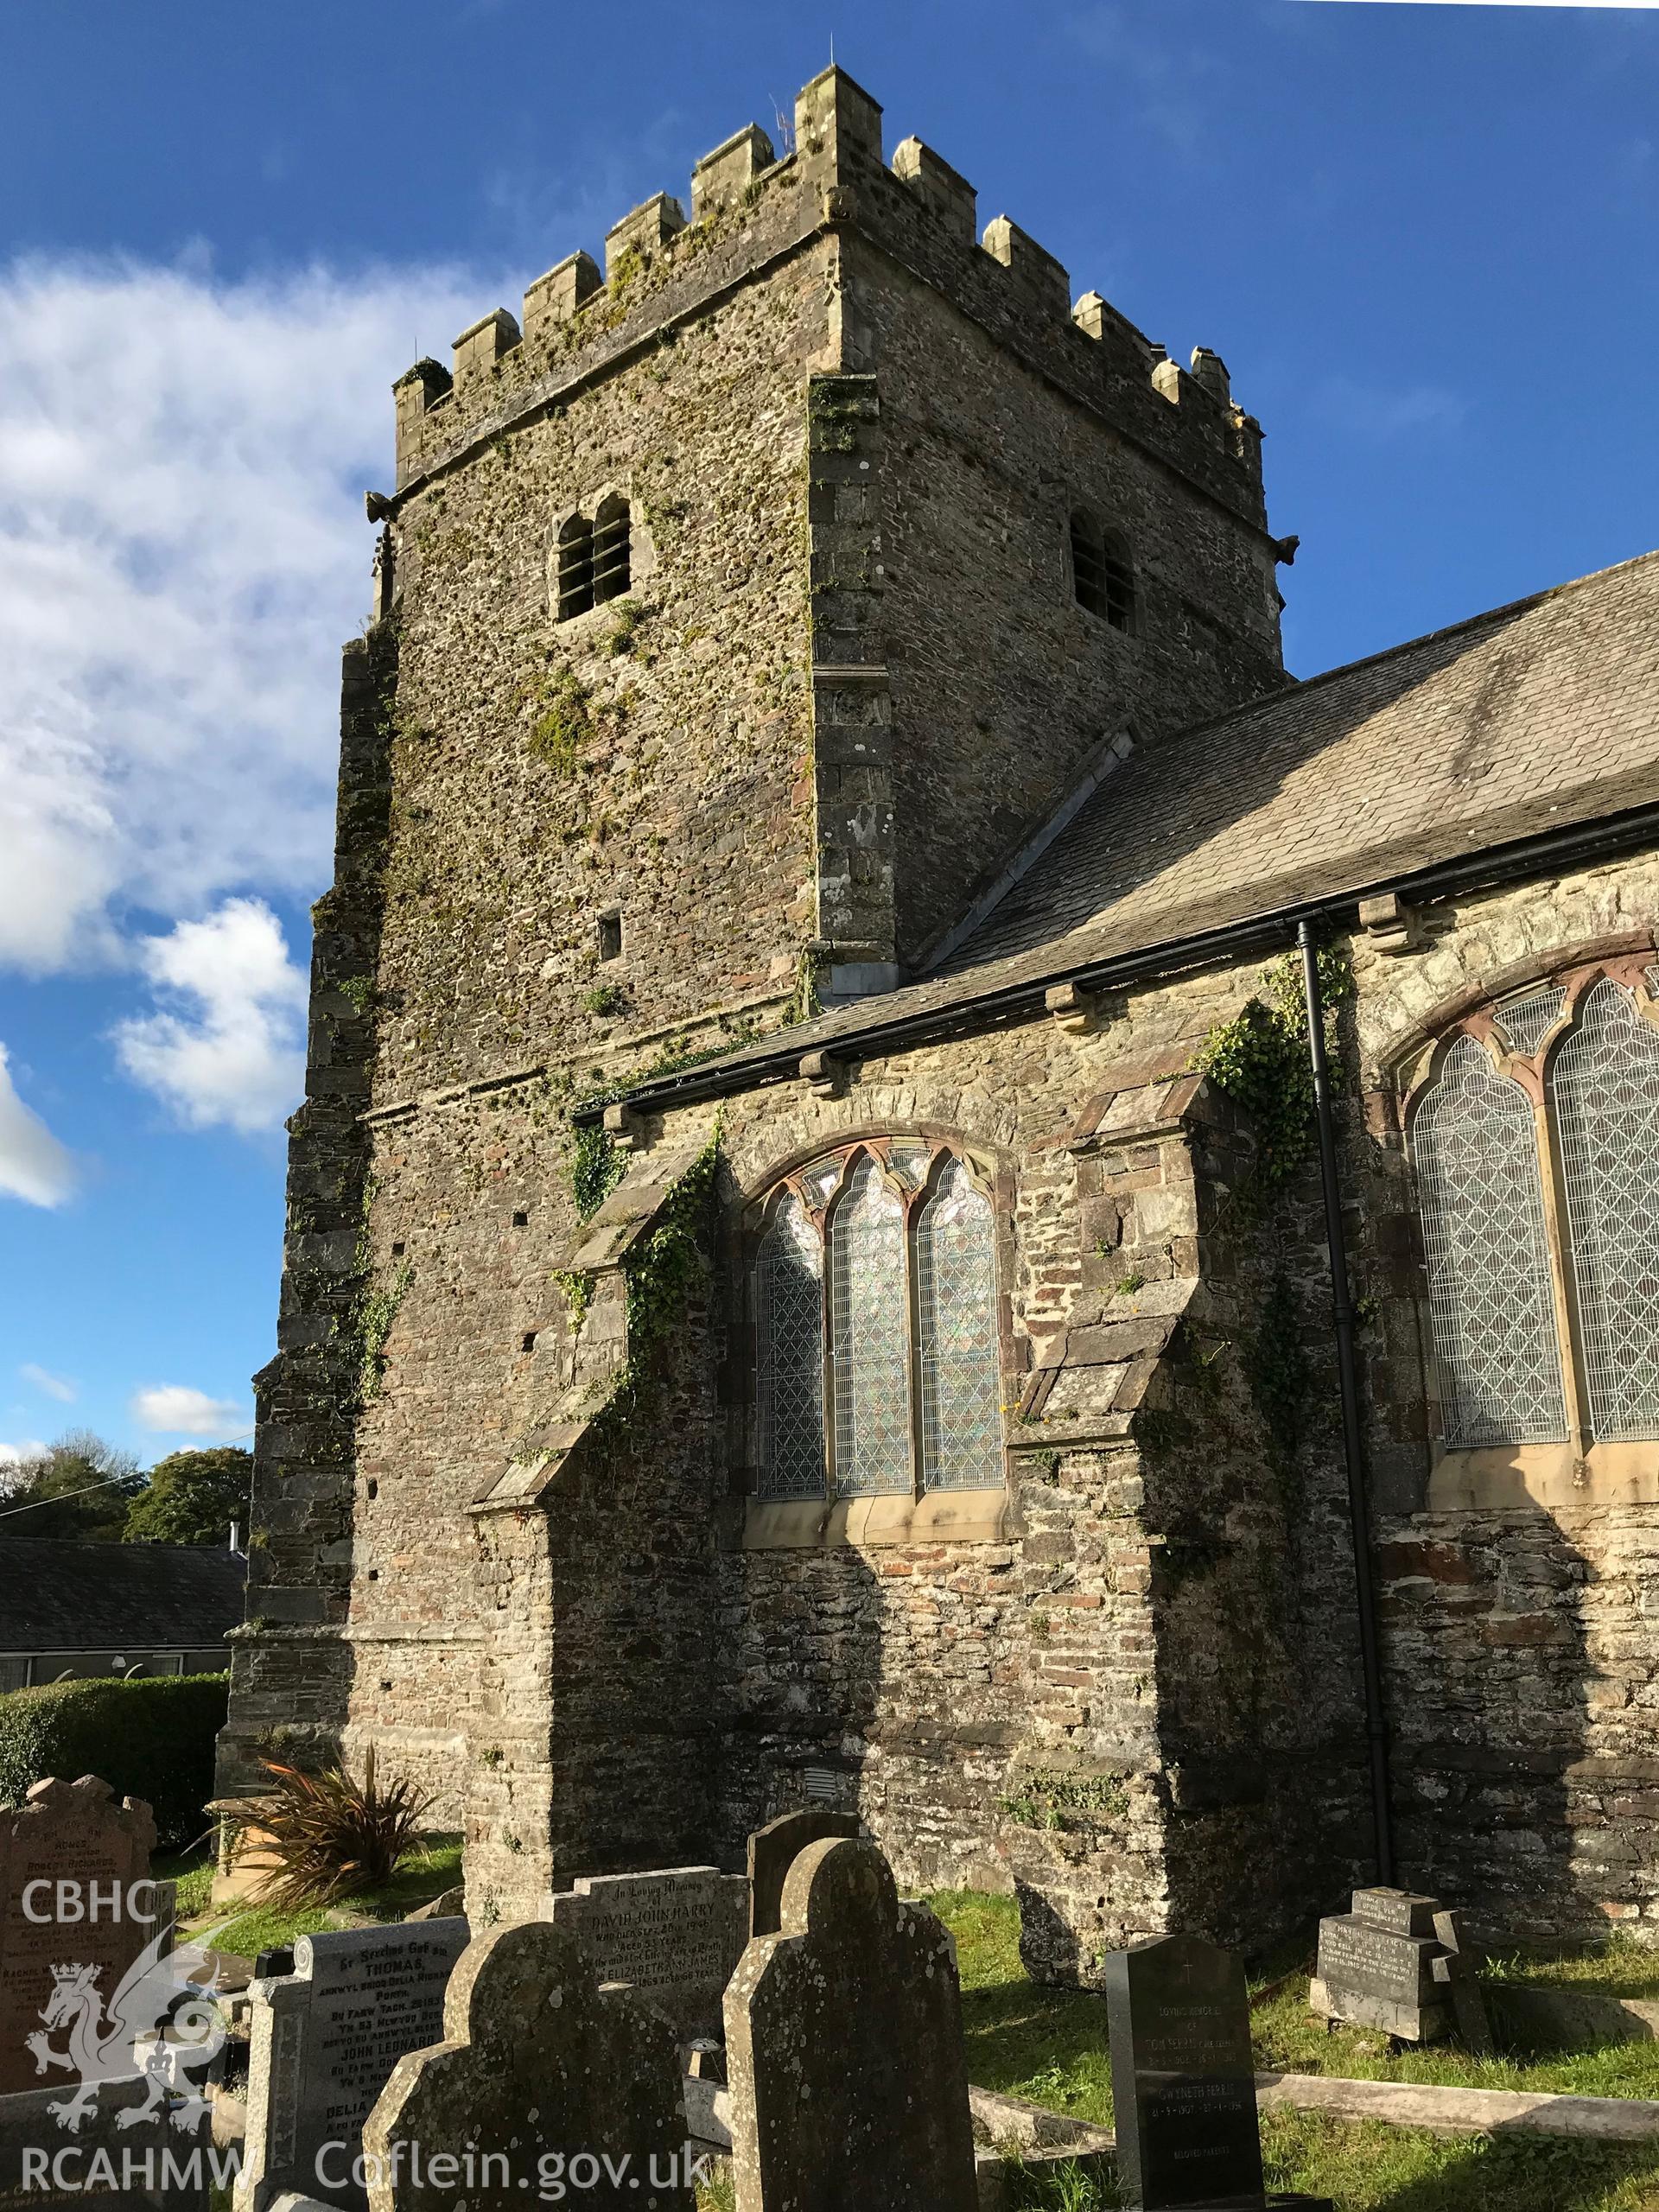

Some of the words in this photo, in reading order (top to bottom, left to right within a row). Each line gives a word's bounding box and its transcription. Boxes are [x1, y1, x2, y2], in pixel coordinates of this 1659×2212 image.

[612, 1885, 625, 1901] In
[629, 1881, 661, 1898] Loving
[664, 1878, 702, 1895] Memory
[591, 1912, 632, 1930] DAVID
[635, 1908, 670, 1925] JOHN
[671, 1903, 715, 1919] HARRY
[620, 1941, 642, 1952] AGED
[607, 1961, 667, 1980] ELIZABETH
[689, 1954, 719, 1968] JAMES
[319, 1985, 358, 1997] ANNWYL
[389, 1976, 415, 1986] DELIA
[347, 2007, 375, 2019] FARW
[341, 2044, 373, 2061] JOHN
[378, 2035, 434, 2055] LEONARD
[326, 2101, 367, 2119] DELIA
